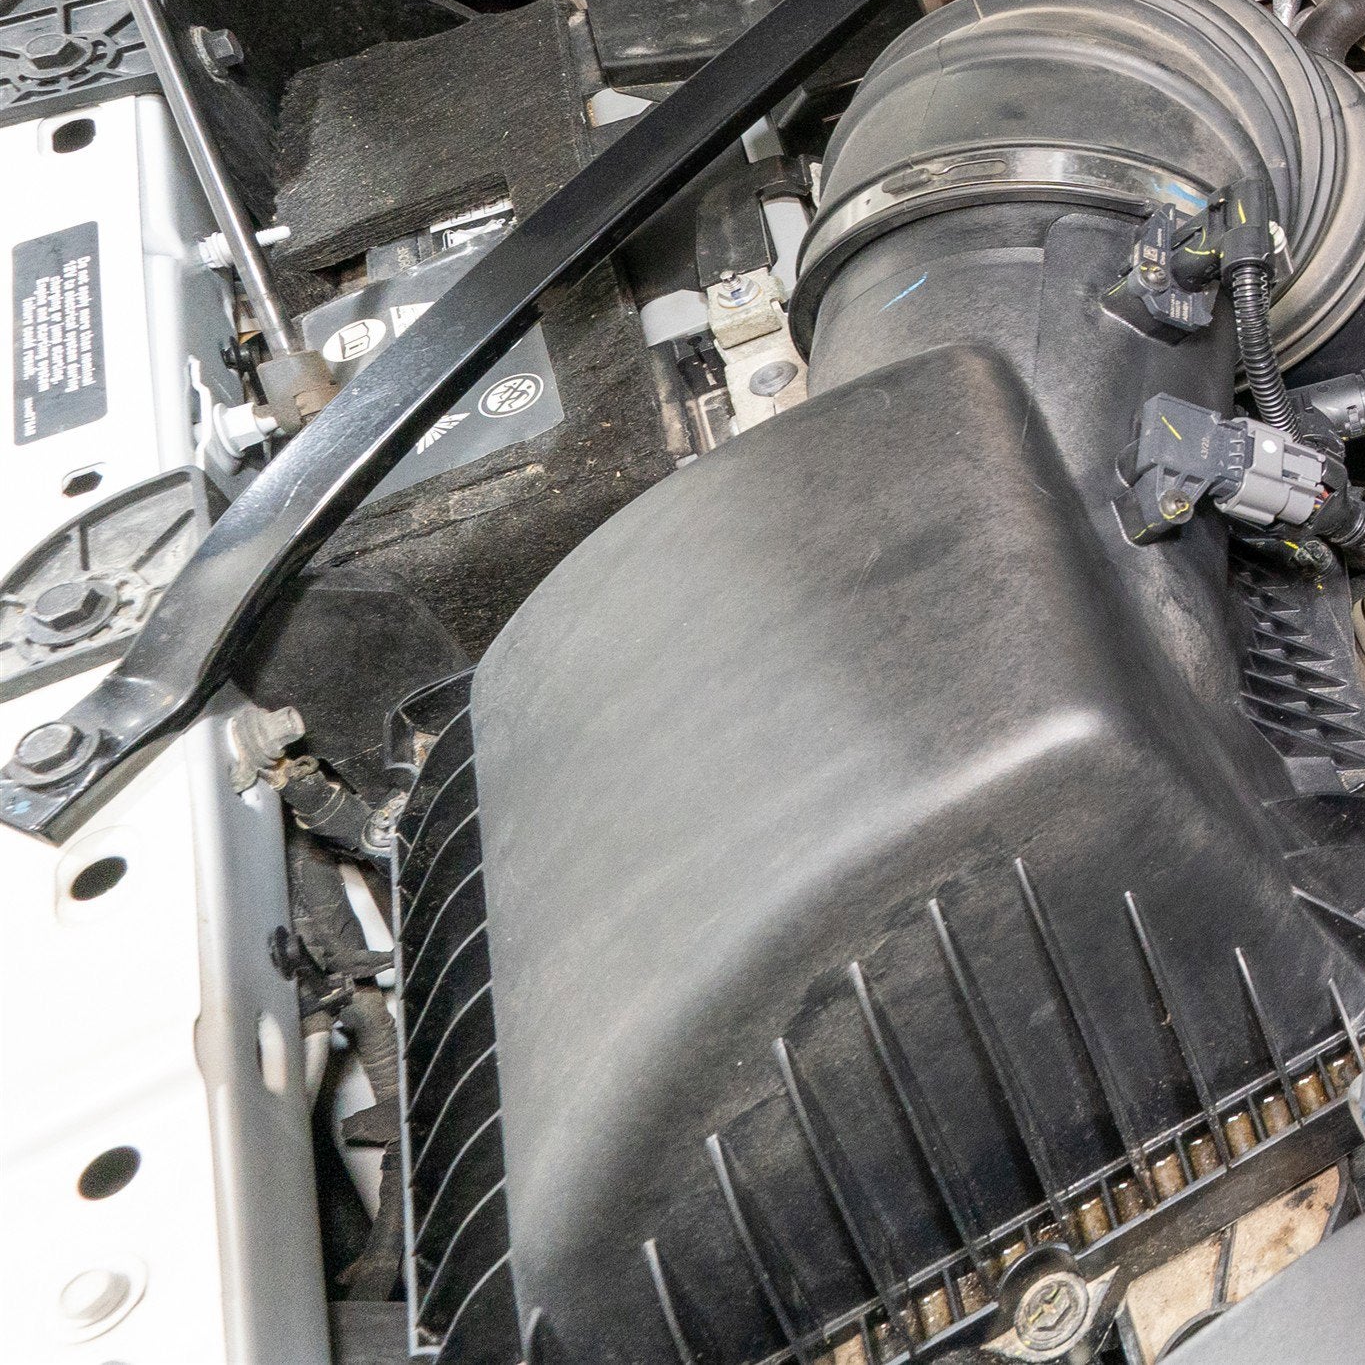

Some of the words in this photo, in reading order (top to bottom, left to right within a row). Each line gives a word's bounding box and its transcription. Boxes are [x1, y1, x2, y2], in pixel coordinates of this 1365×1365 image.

[63, 259, 77, 278] 12V
[77, 255, 91, 270] Do
[64, 278, 76, 290] to
[77, 269, 89, 285] not
[34, 276, 50, 306] Engine
[76, 284, 92, 308] apply
[36, 306, 50, 323] and
[79, 307, 91, 330] more
[22, 325, 37, 350] could
[49, 322, 65, 344] jump
[80, 330, 94, 352] than
[62, 330, 78, 363] system
[37, 359, 50, 393] system
[65, 362, 81, 393] during
[81, 352, 96, 388] nominal
